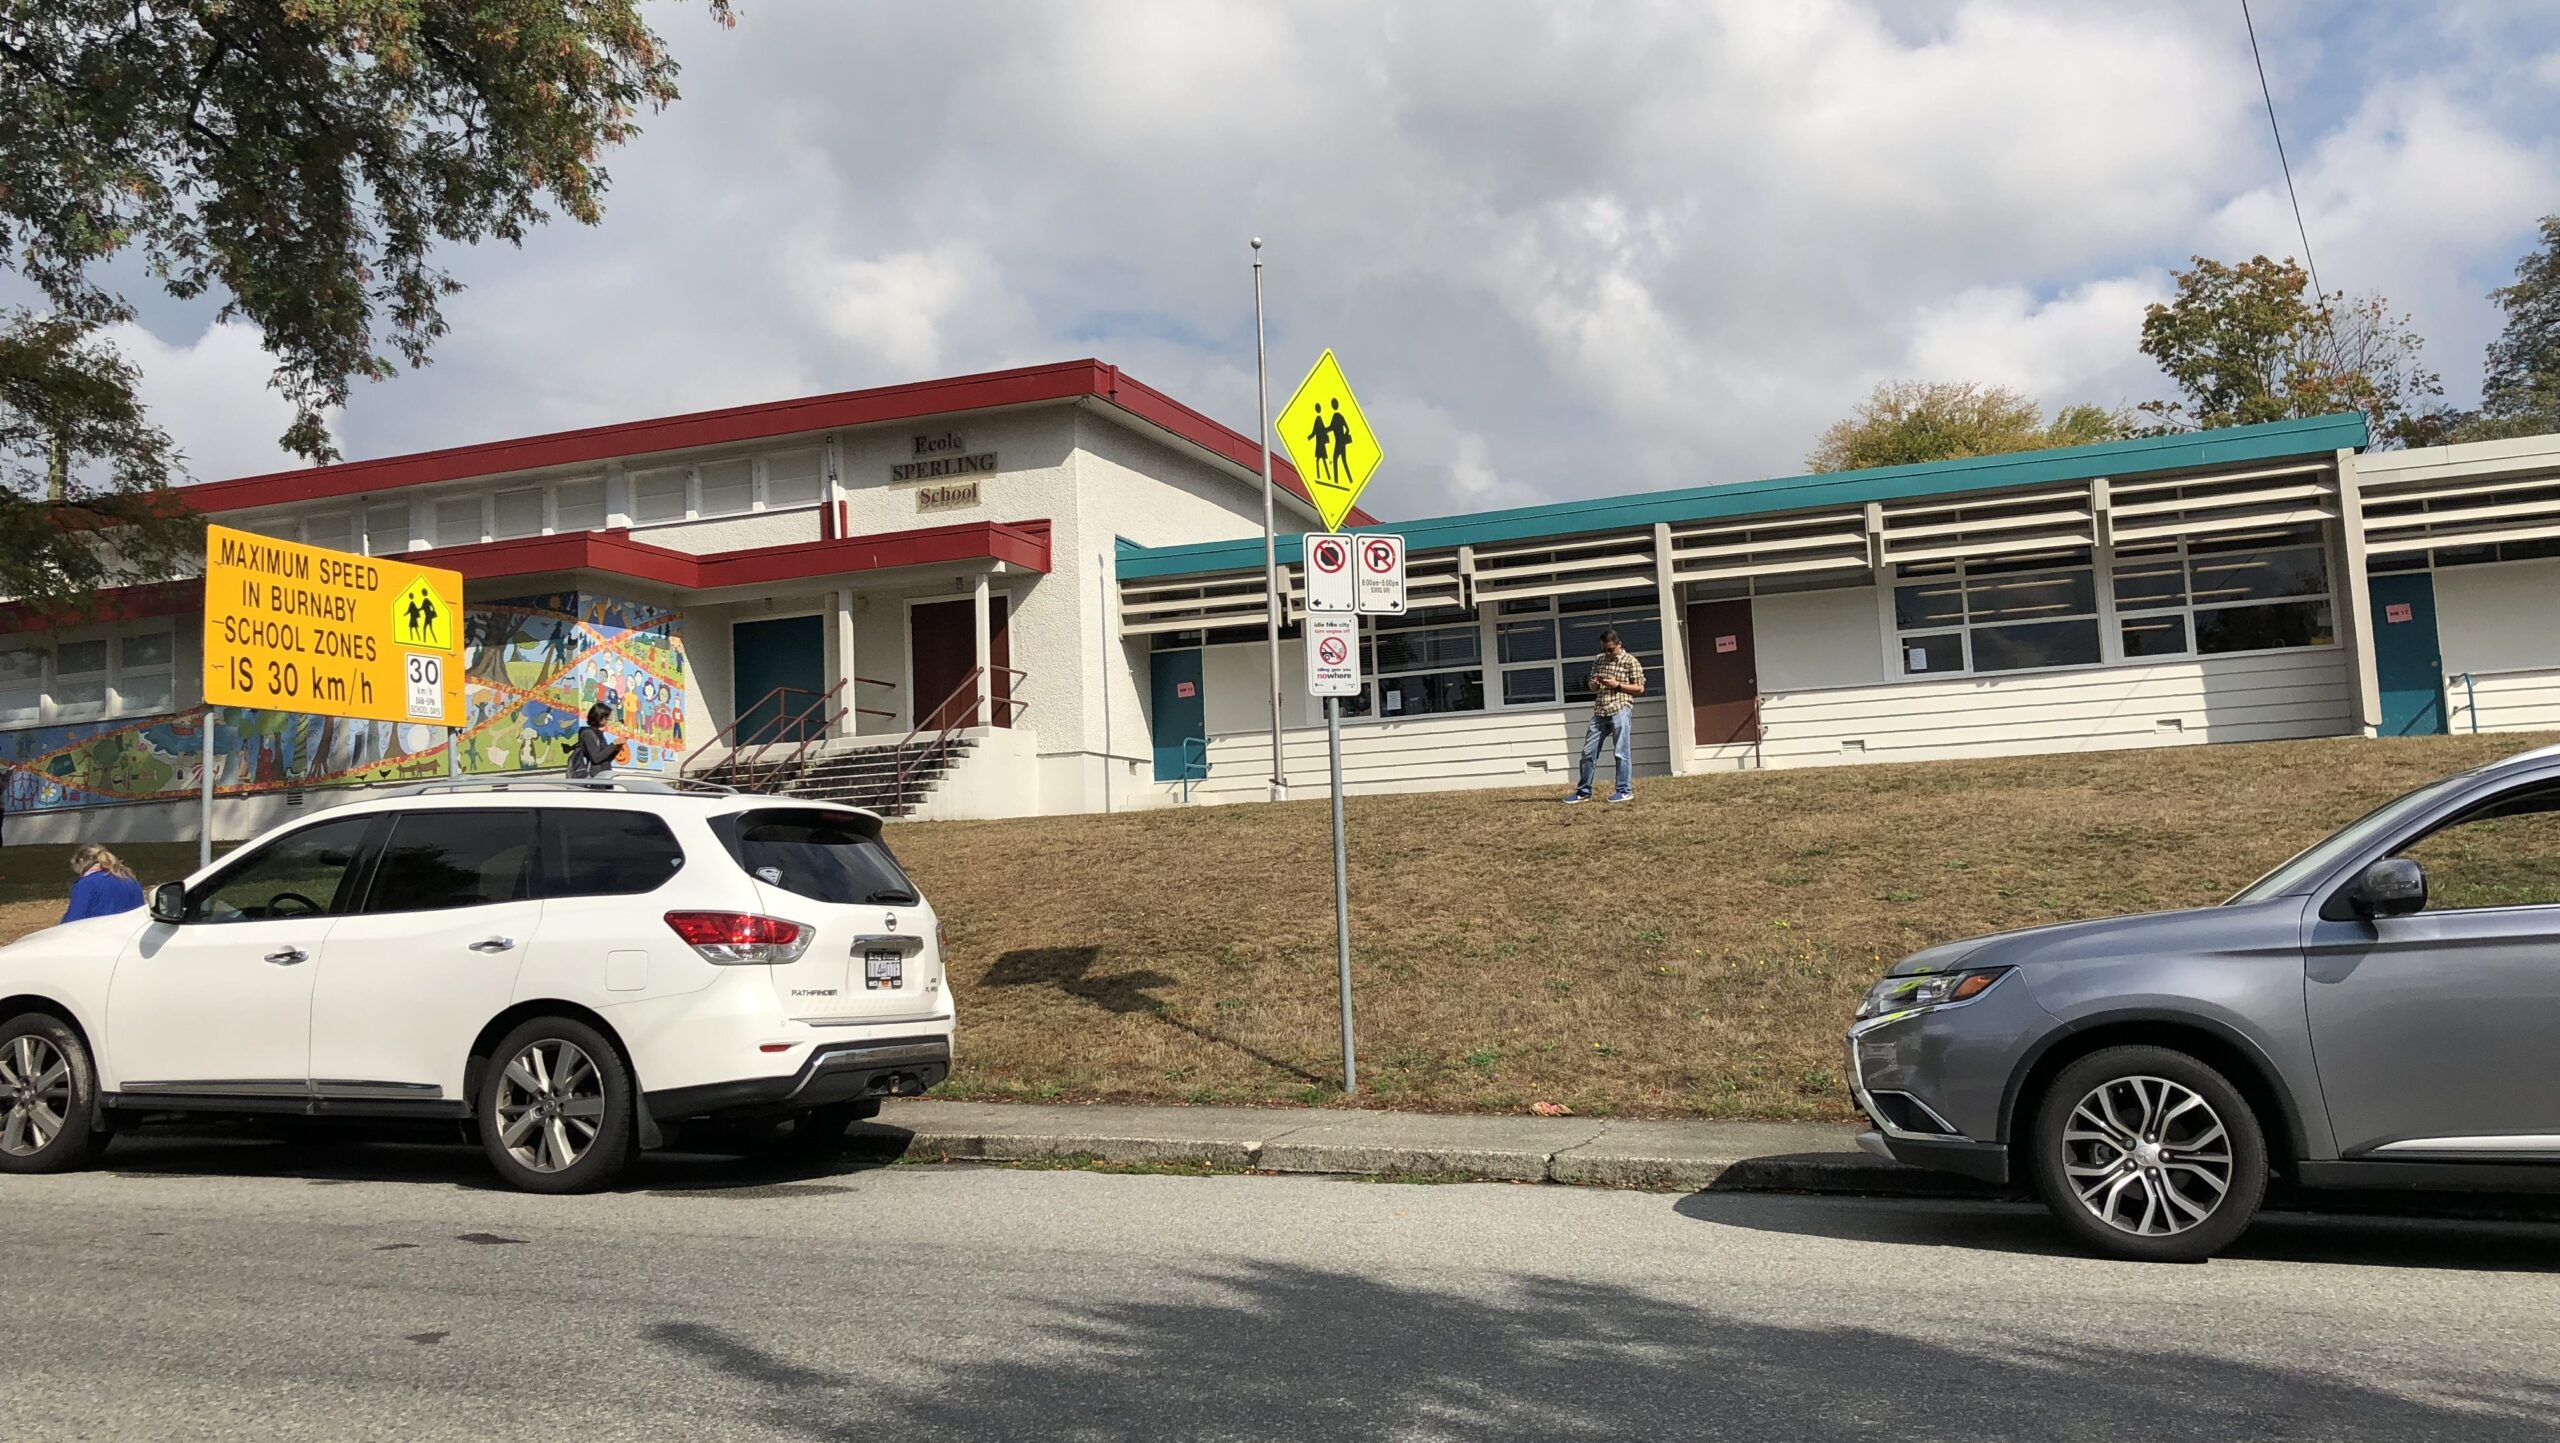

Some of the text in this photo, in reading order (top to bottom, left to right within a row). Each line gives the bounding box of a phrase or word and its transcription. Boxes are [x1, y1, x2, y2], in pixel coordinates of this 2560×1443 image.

[914, 432, 962, 453] Ecole
[892, 454, 994, 482] SPERLING
[920, 482, 977, 505] School
[221, 538, 379, 592] MAXIMUM SPEED
[242, 580, 357, 623] IN BURNABY
[224, 615, 377, 662] SCHOOL ZONES
[230, 656, 373, 706] IS 30 km/h
[410, 658, 439, 685] 30
[1317, 671, 1352, 679] nowhere
[791, 989, 839, 998] PATHFINDER
